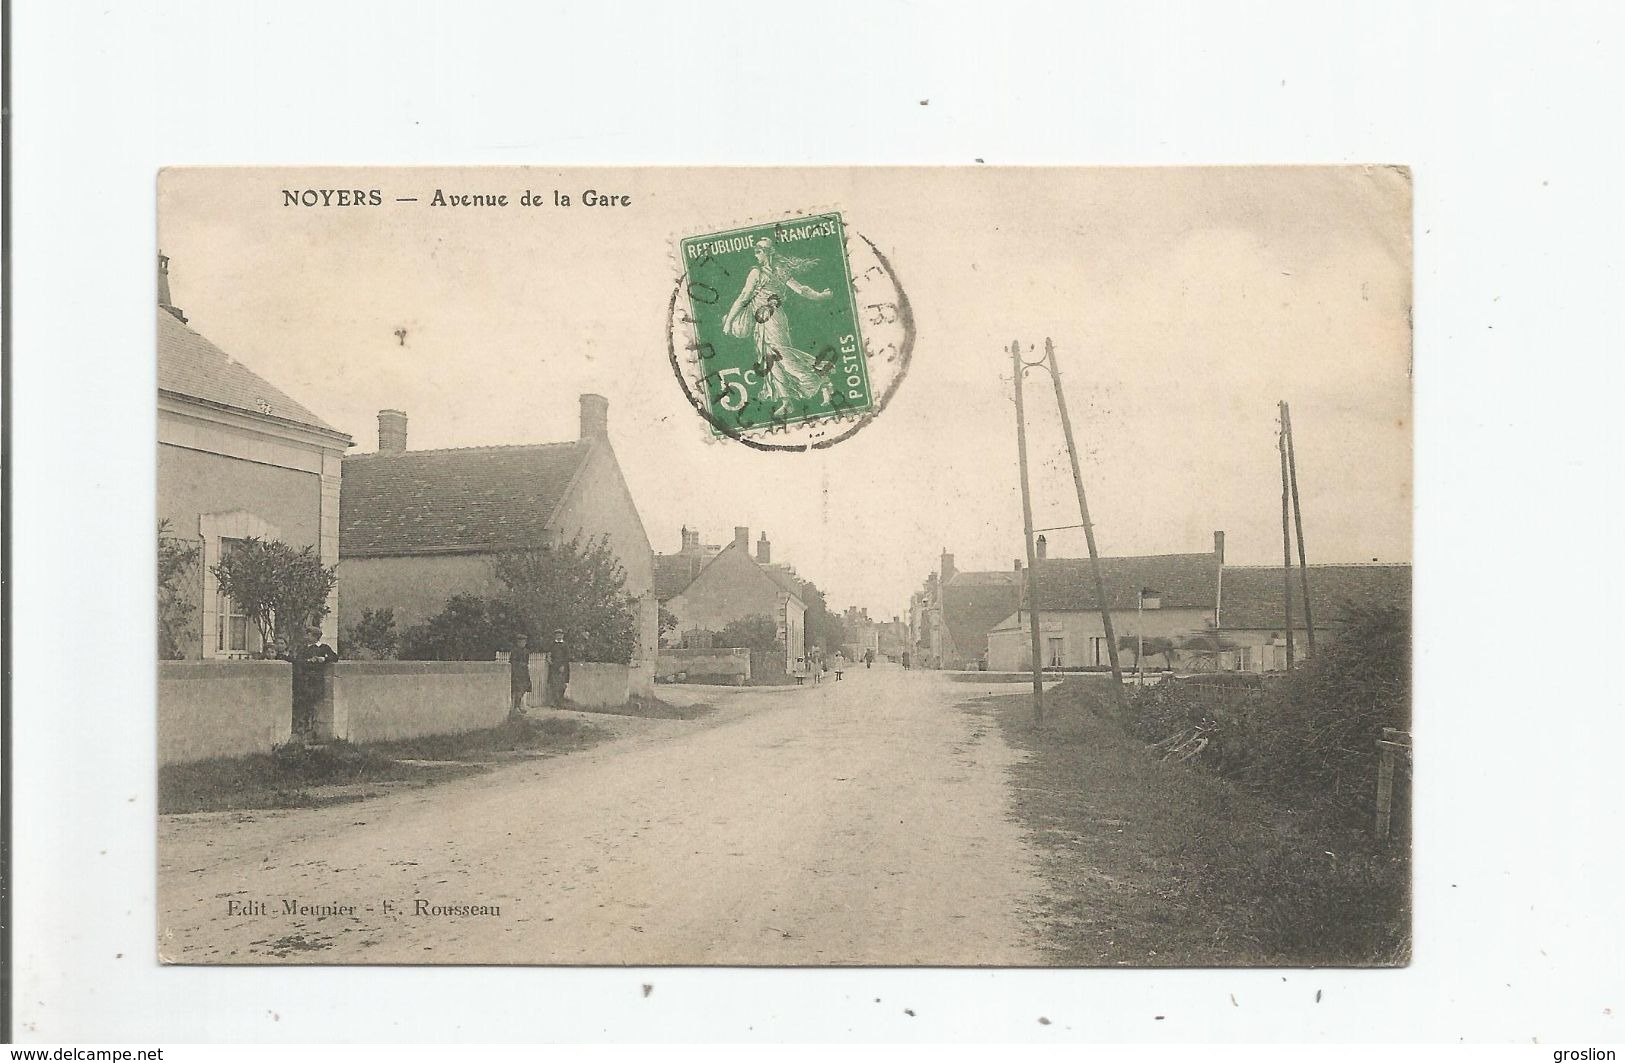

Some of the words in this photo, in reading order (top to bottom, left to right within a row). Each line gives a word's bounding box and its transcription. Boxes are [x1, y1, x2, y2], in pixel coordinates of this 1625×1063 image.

[282, 189, 382, 207] NOYERS
[430, 189, 509, 207] Avenue
[520, 189, 544, 207] de
[553, 189, 571, 207] la
[581, 189, 632, 207] Gare
[839, 333, 861, 401] POSTES
[227, 900, 268, 917] Edit
[281, 899, 358, 917] Meunier
[413, 899, 501, 917] Rousseau
